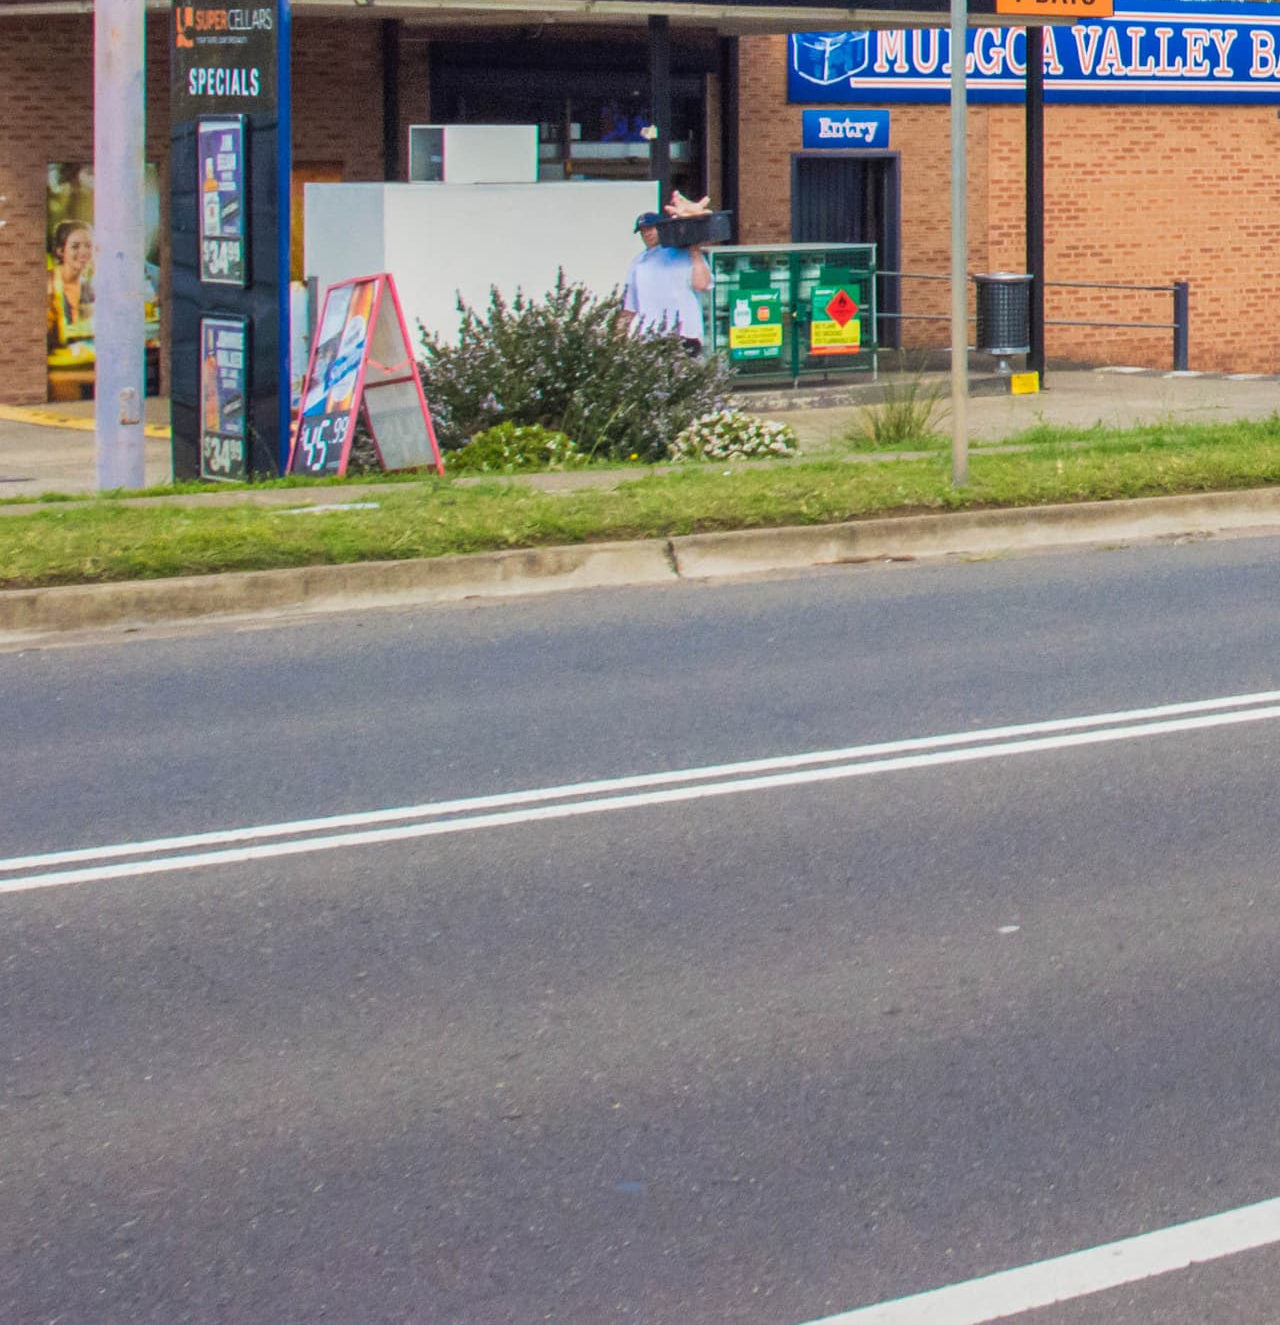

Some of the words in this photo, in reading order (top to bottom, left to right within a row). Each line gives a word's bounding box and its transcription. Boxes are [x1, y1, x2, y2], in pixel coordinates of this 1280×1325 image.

[195, 8, 273, 31] SUPERCELLARS
[873, 26, 1063, 74] MUGOA
[1071, 24, 1238, 77] VALLEY
[188, 67, 262, 96] SPECIALS
[818, 117, 878, 142] Entry
